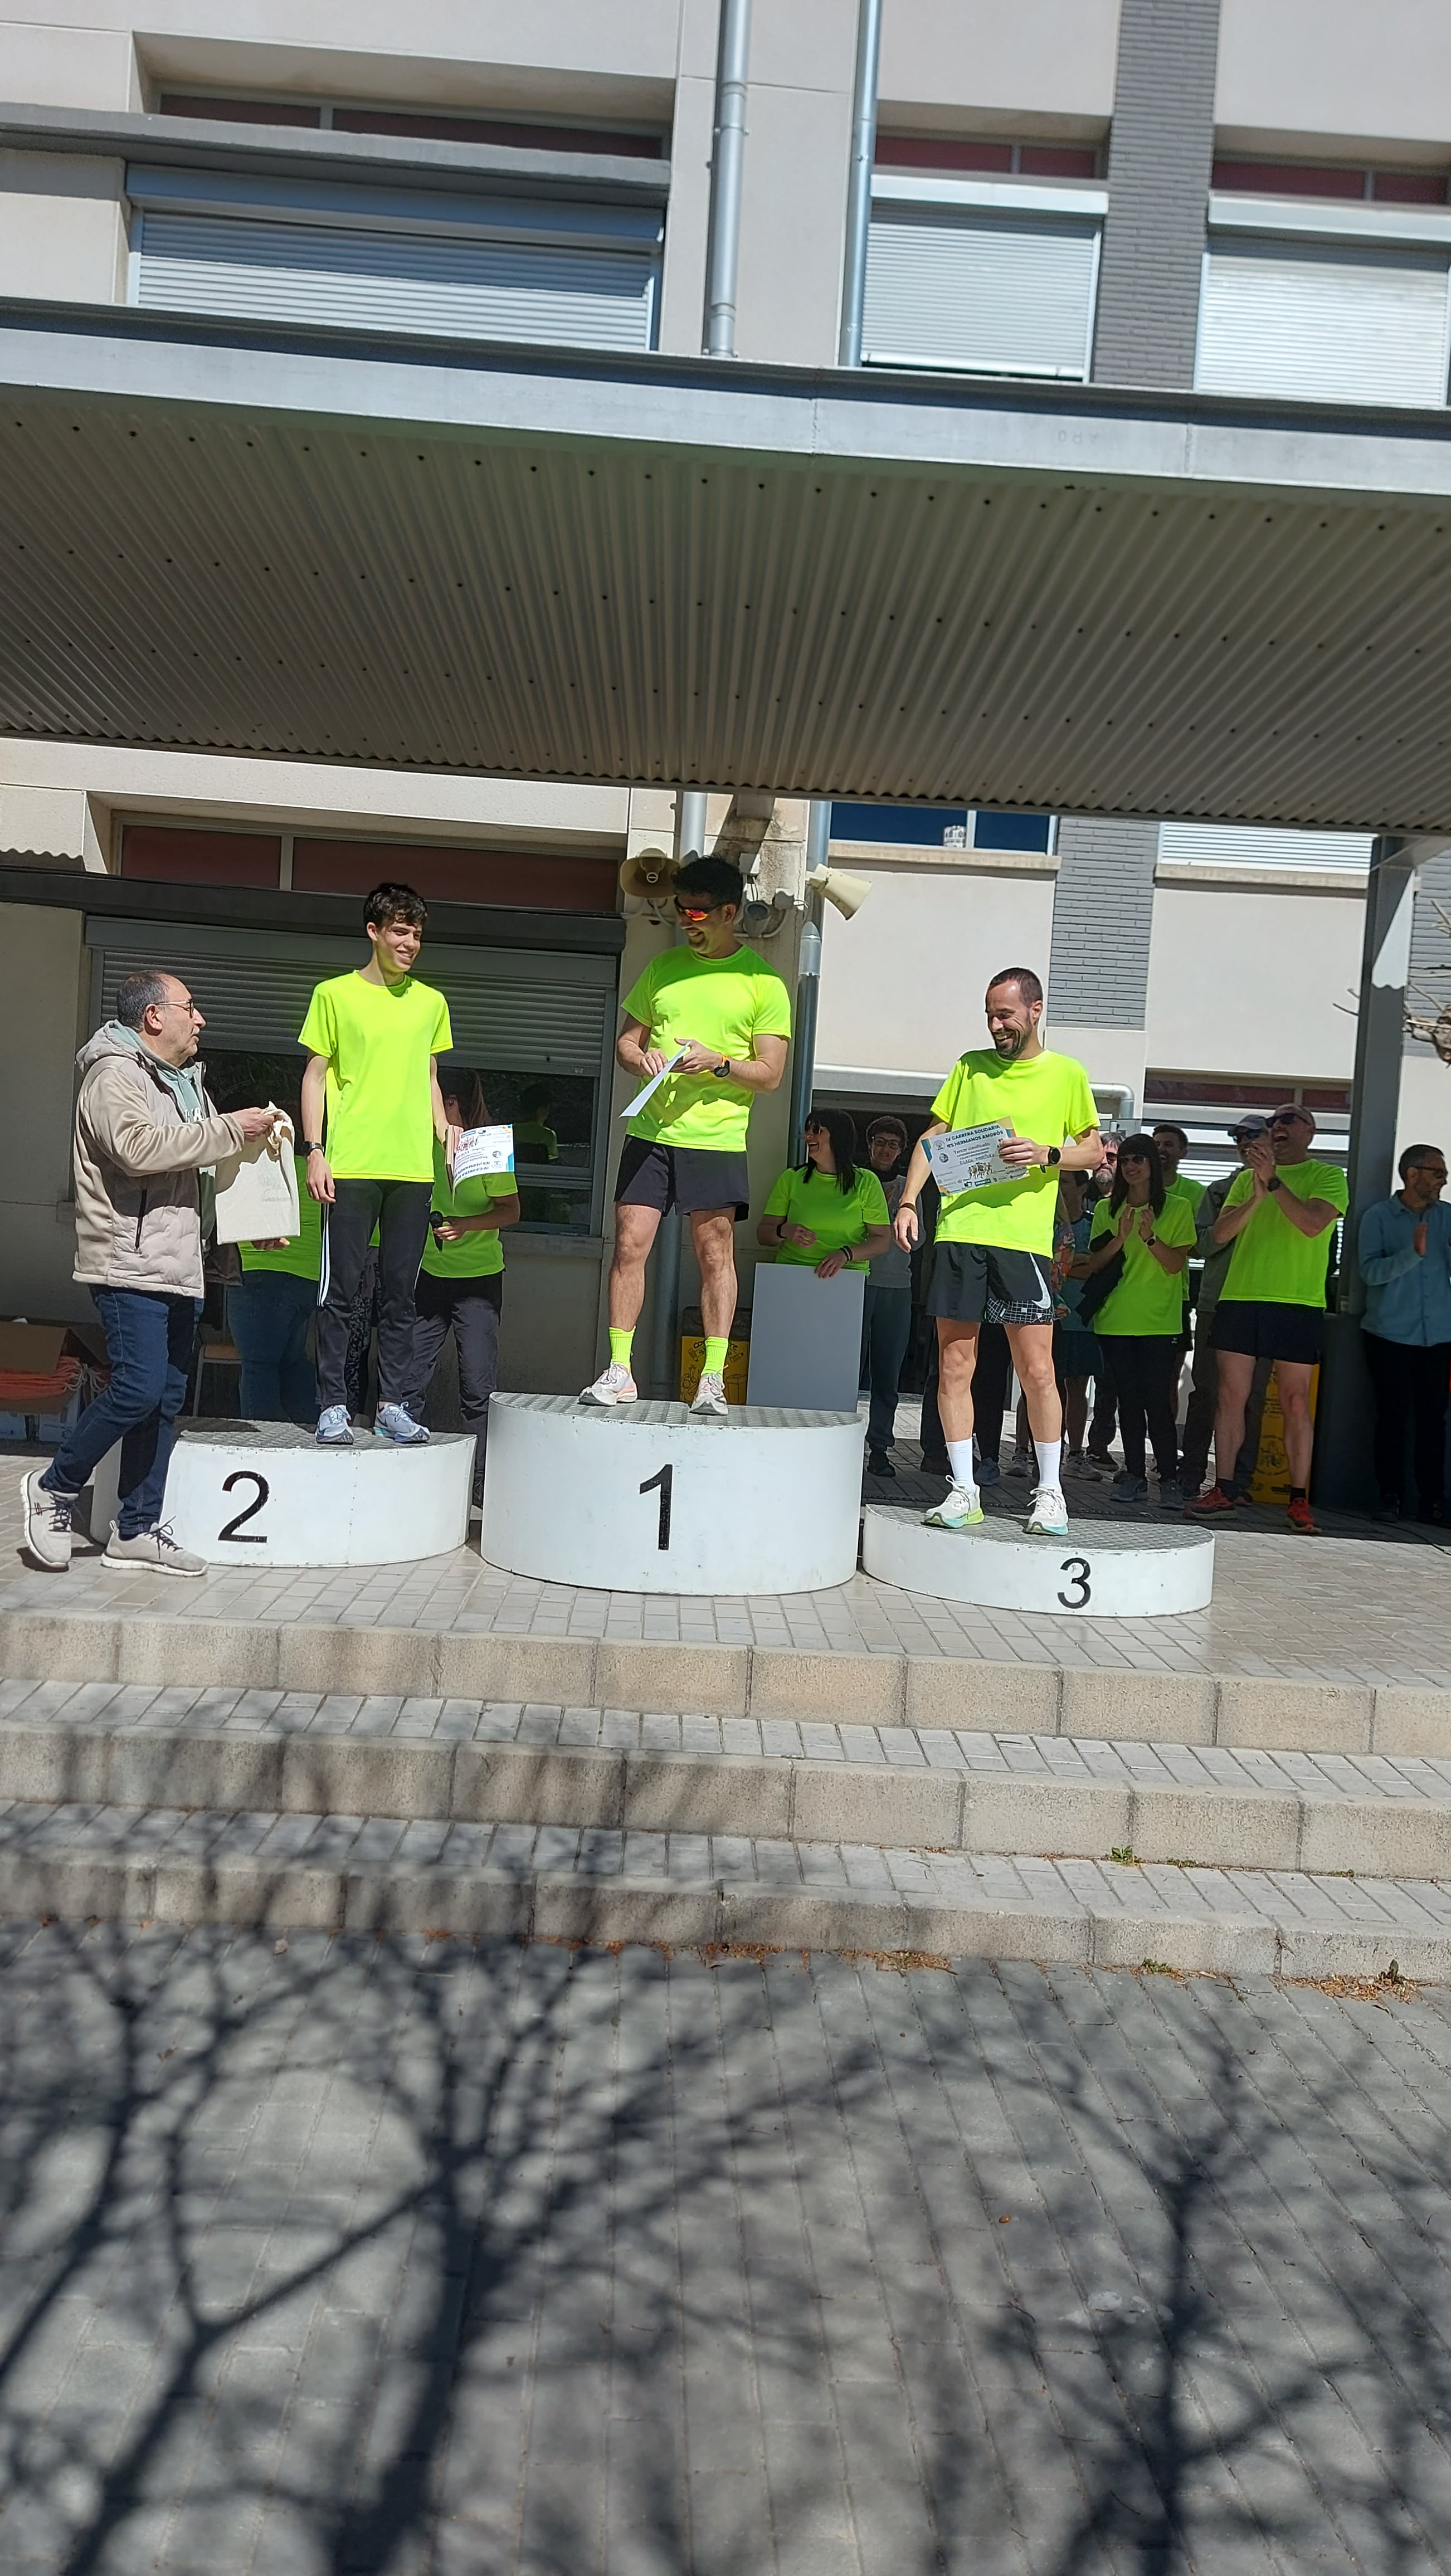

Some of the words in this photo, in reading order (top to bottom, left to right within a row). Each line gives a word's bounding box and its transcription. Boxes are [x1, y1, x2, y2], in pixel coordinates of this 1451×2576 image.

[952, 1131, 974, 1140] CARRERA
[974, 1125, 1001, 1134] SOLIDARIA
[955, 1135, 981, 1146] HERMANOS
[982, 1130, 1004, 1139] AMORÓS
[218, 1471, 270, 1543] 2
[640, 1464, 673, 1550] 1
[1057, 1558, 1091, 1609] 3
